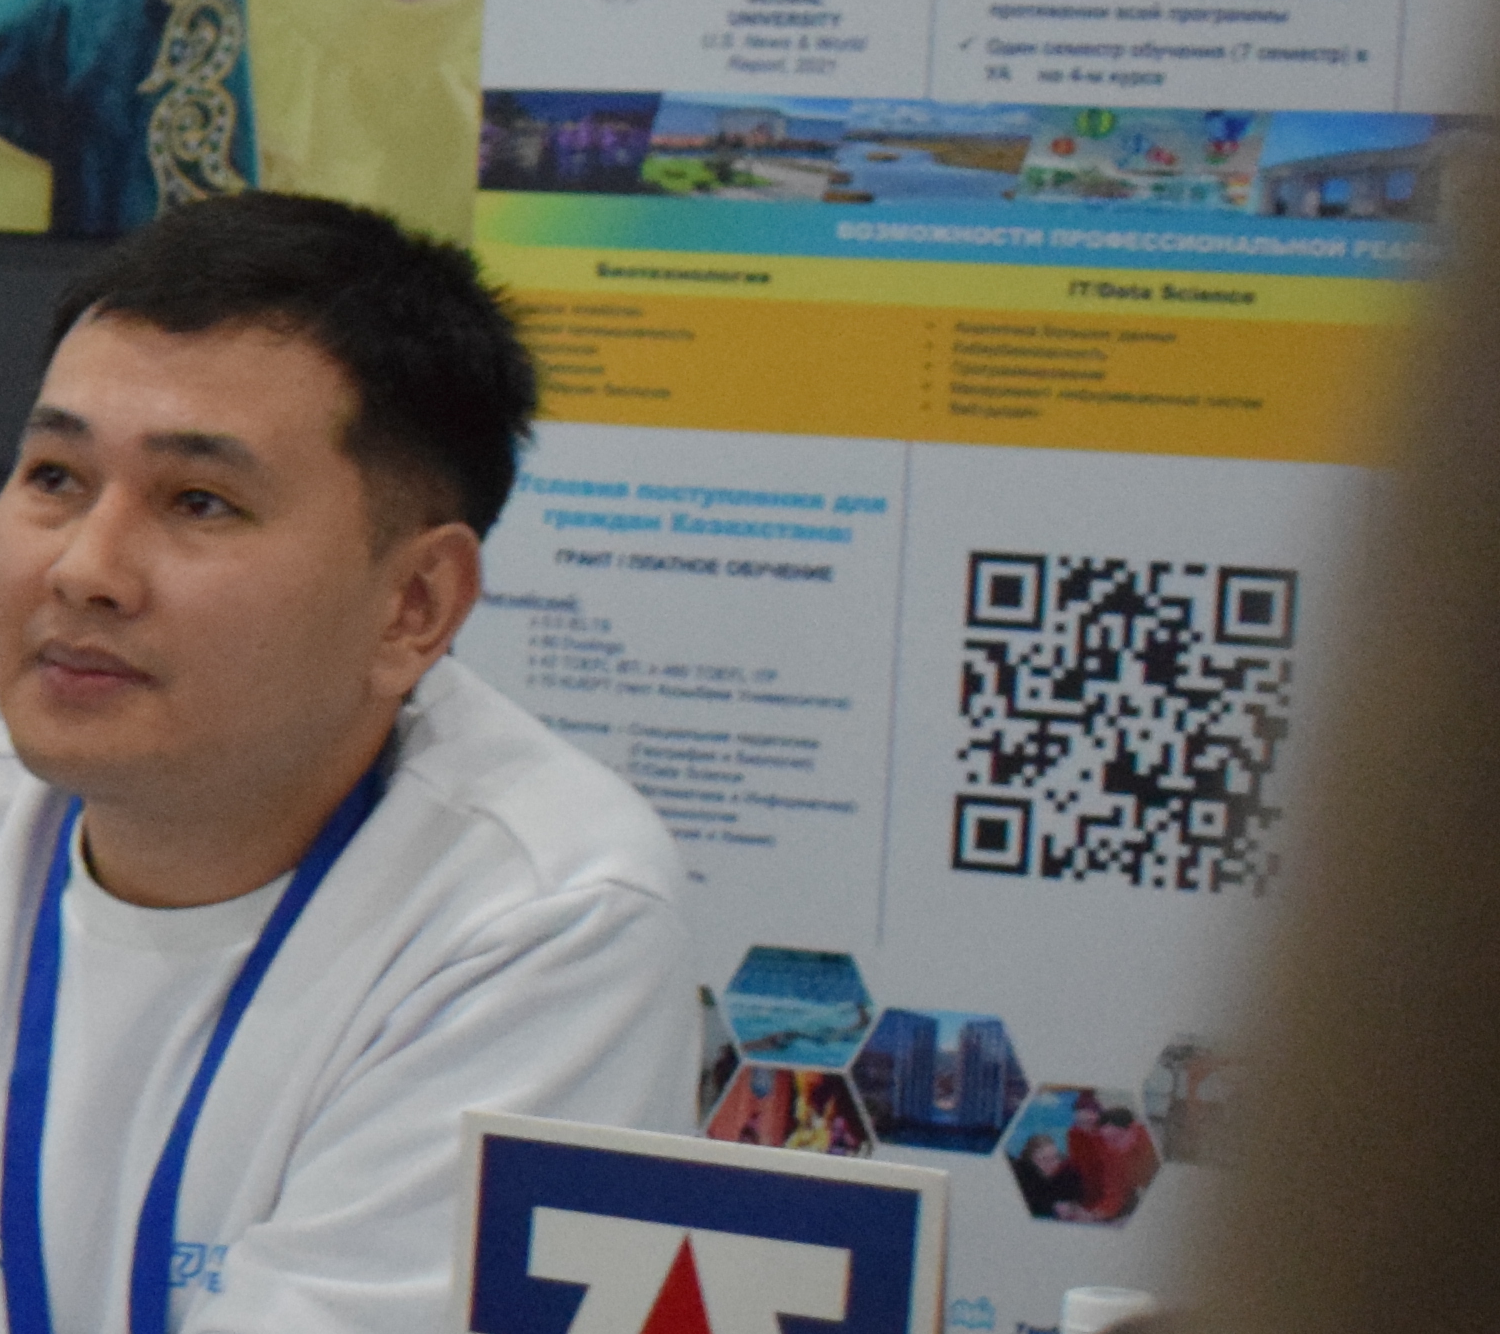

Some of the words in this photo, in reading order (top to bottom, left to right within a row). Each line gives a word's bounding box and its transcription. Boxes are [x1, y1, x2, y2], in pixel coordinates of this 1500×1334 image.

[836, 219, 1045, 247] ВОЗМОЖНОСТИ
[1161, 283, 1256, 304] Science
[635, 483, 826, 510] поступления
